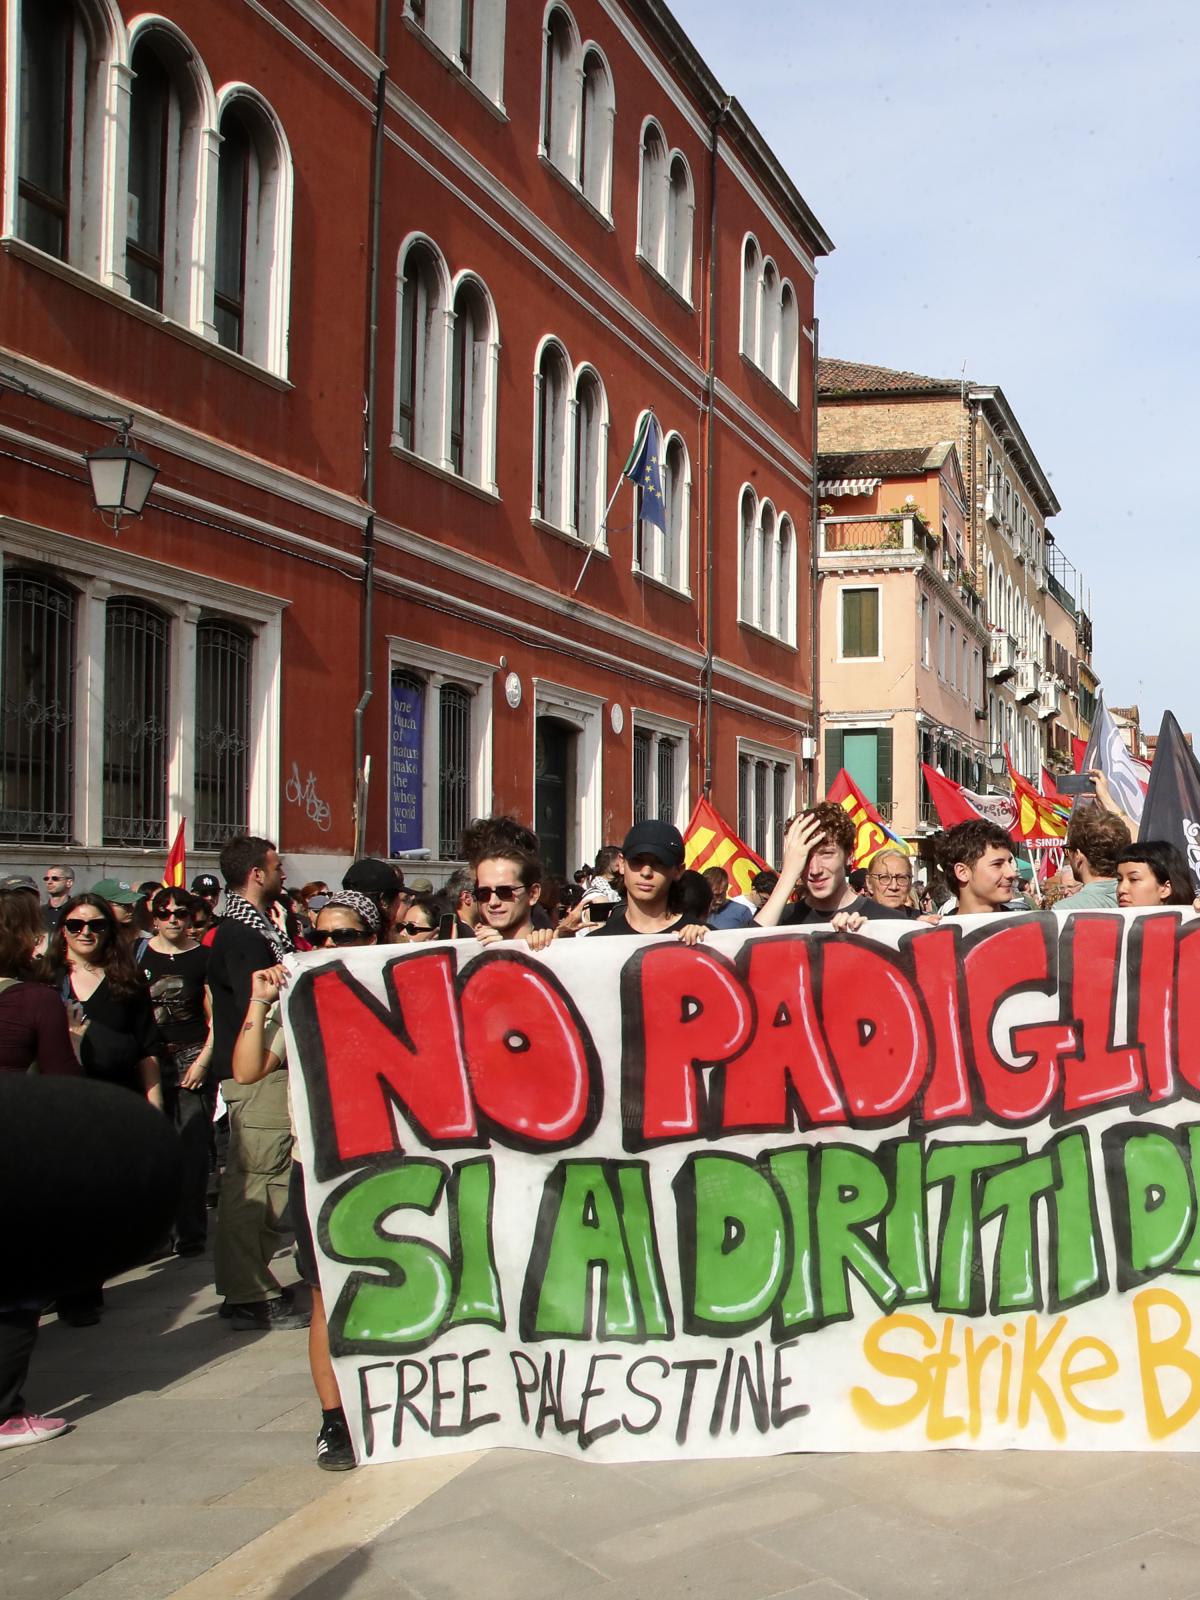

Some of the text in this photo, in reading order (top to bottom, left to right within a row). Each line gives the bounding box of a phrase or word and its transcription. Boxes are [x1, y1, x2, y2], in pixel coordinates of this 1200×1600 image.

[394, 700, 411, 713] one
[393, 773, 408, 788] the
[394, 819, 408, 834] kin
[290, 947, 603, 1182] NO
[317, 1155, 505, 1357] SI
[520, 1158, 675, 1344] AI
[672, 1124, 1109, 1344] DIRITTI
[358, 1349, 501, 1457] FREE
[509, 1340, 810, 1450] PALESTINE
[850, 1312, 1126, 1443] Strike
